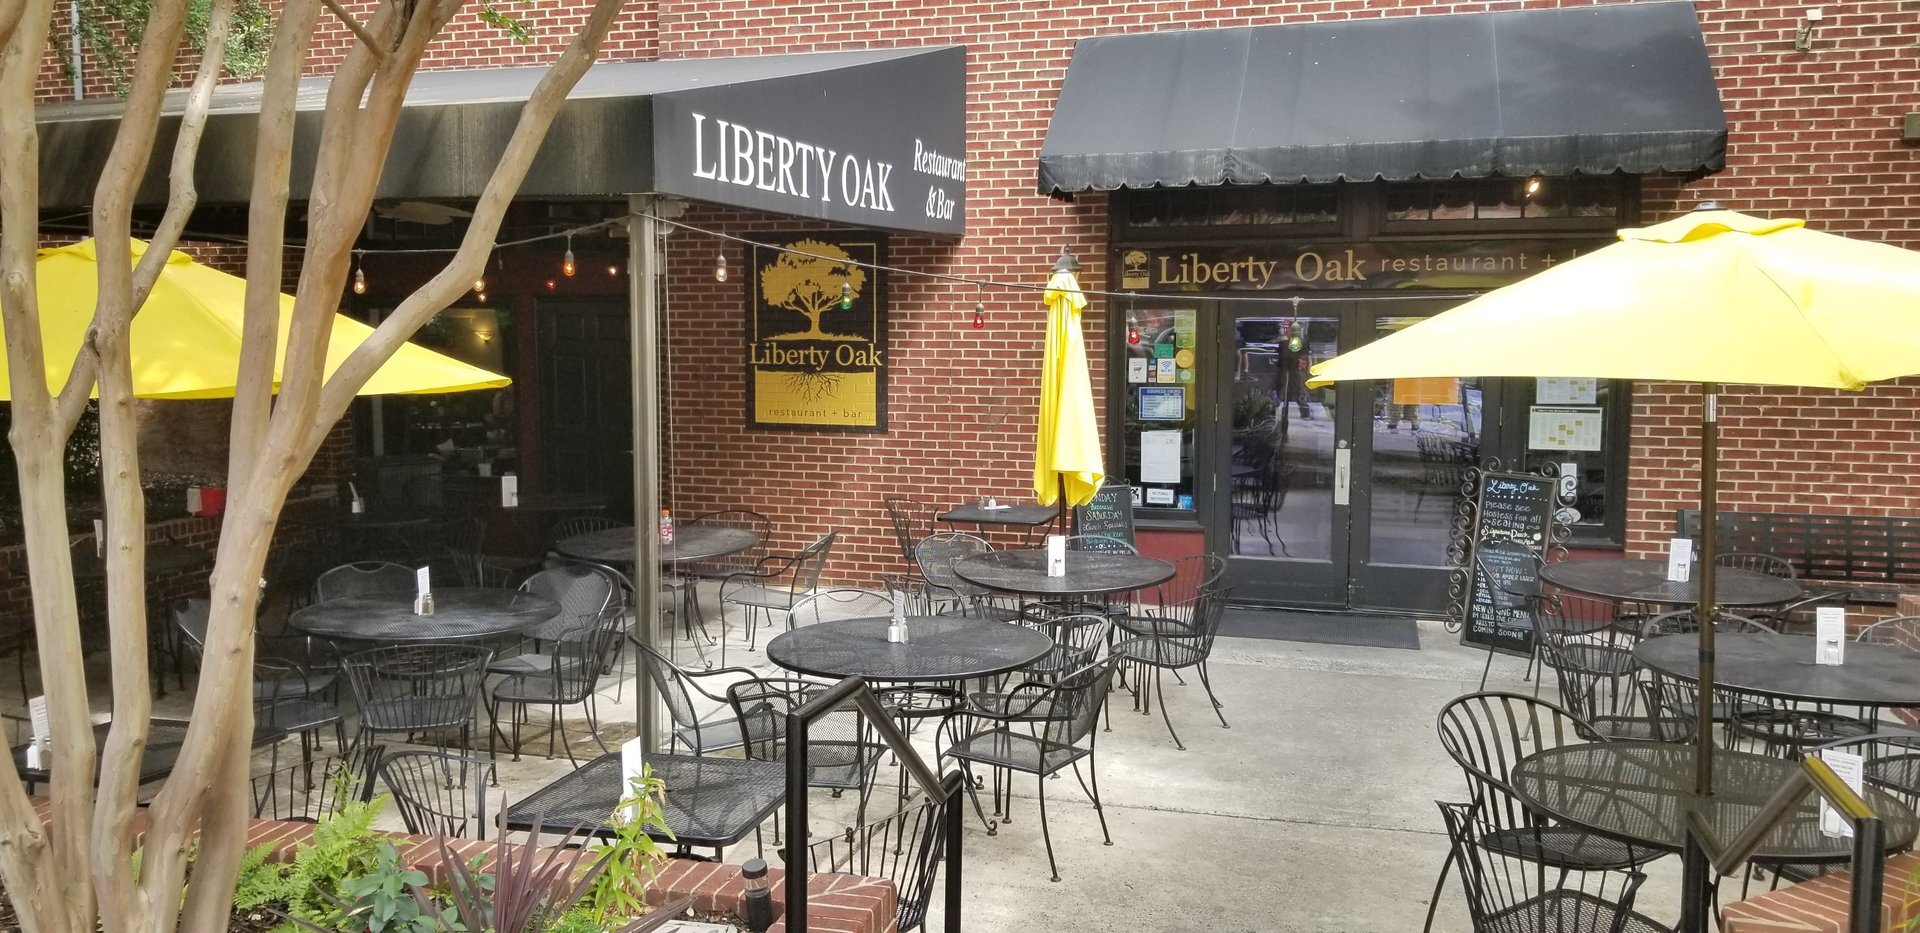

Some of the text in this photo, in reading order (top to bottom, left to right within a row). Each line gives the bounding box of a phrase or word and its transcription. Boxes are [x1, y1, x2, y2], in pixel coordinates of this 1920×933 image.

[692, 112, 895, 212] LIBERTY OAK
[913, 138, 966, 183] Restaurant
[1158, 253, 1277, 289] Liberty
[1295, 250, 1366, 283] Oak
[1381, 252, 1528, 272] restaurant
[749, 342, 883, 371] Liberty Oak
[769, 407, 827, 418] restaurant
[843, 407, 862, 418] bar
[1519, 482, 1540, 494] Oak
[1086, 510, 1123, 521] SATURDAY
[1515, 504, 1531, 512] see
